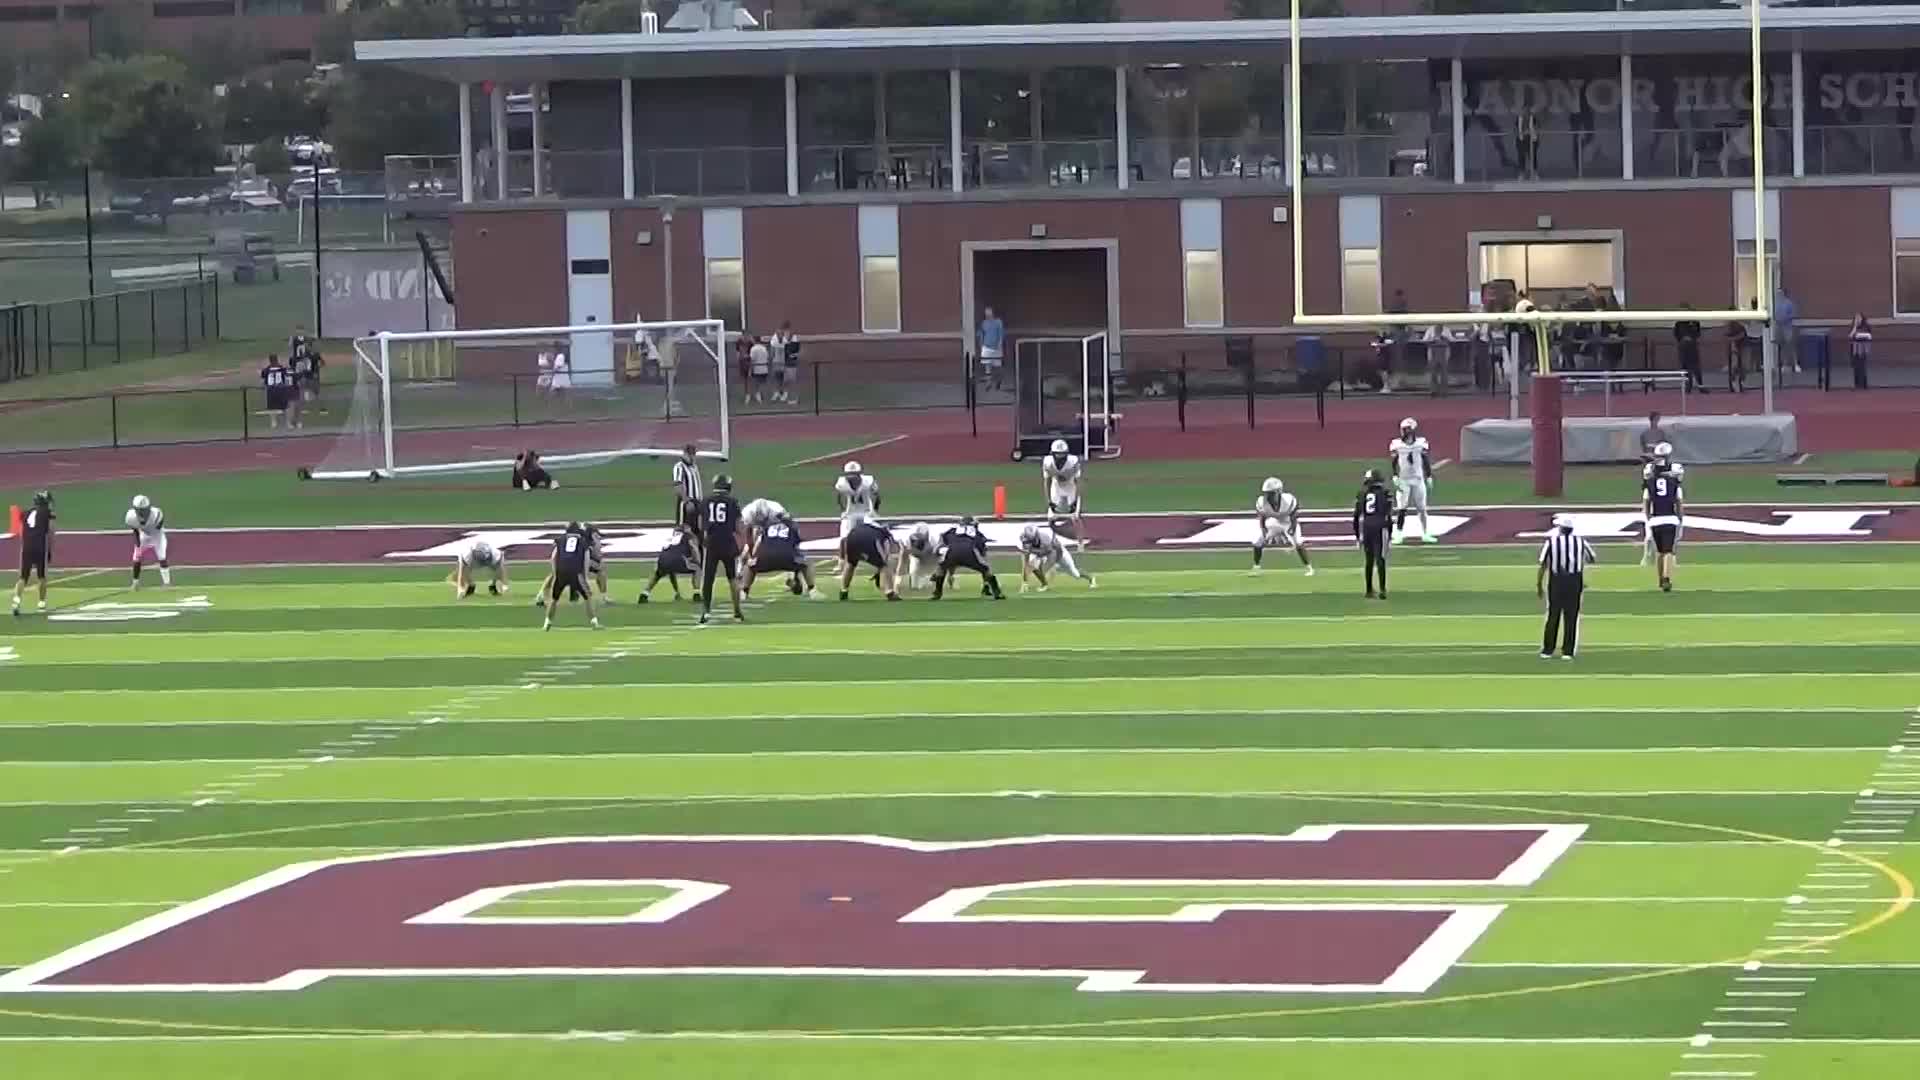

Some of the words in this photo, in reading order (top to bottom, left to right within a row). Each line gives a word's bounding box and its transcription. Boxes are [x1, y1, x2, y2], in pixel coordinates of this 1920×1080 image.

[1436, 78, 1661, 115] RADNOR
[1674, 75, 1803, 111] HIGH
[1656, 478, 1667, 496] 9
[708, 502, 727, 523] 16
[1366, 493, 1377, 513] 2
[27, 510, 37, 528] 4
[565, 536, 578, 552] 8
